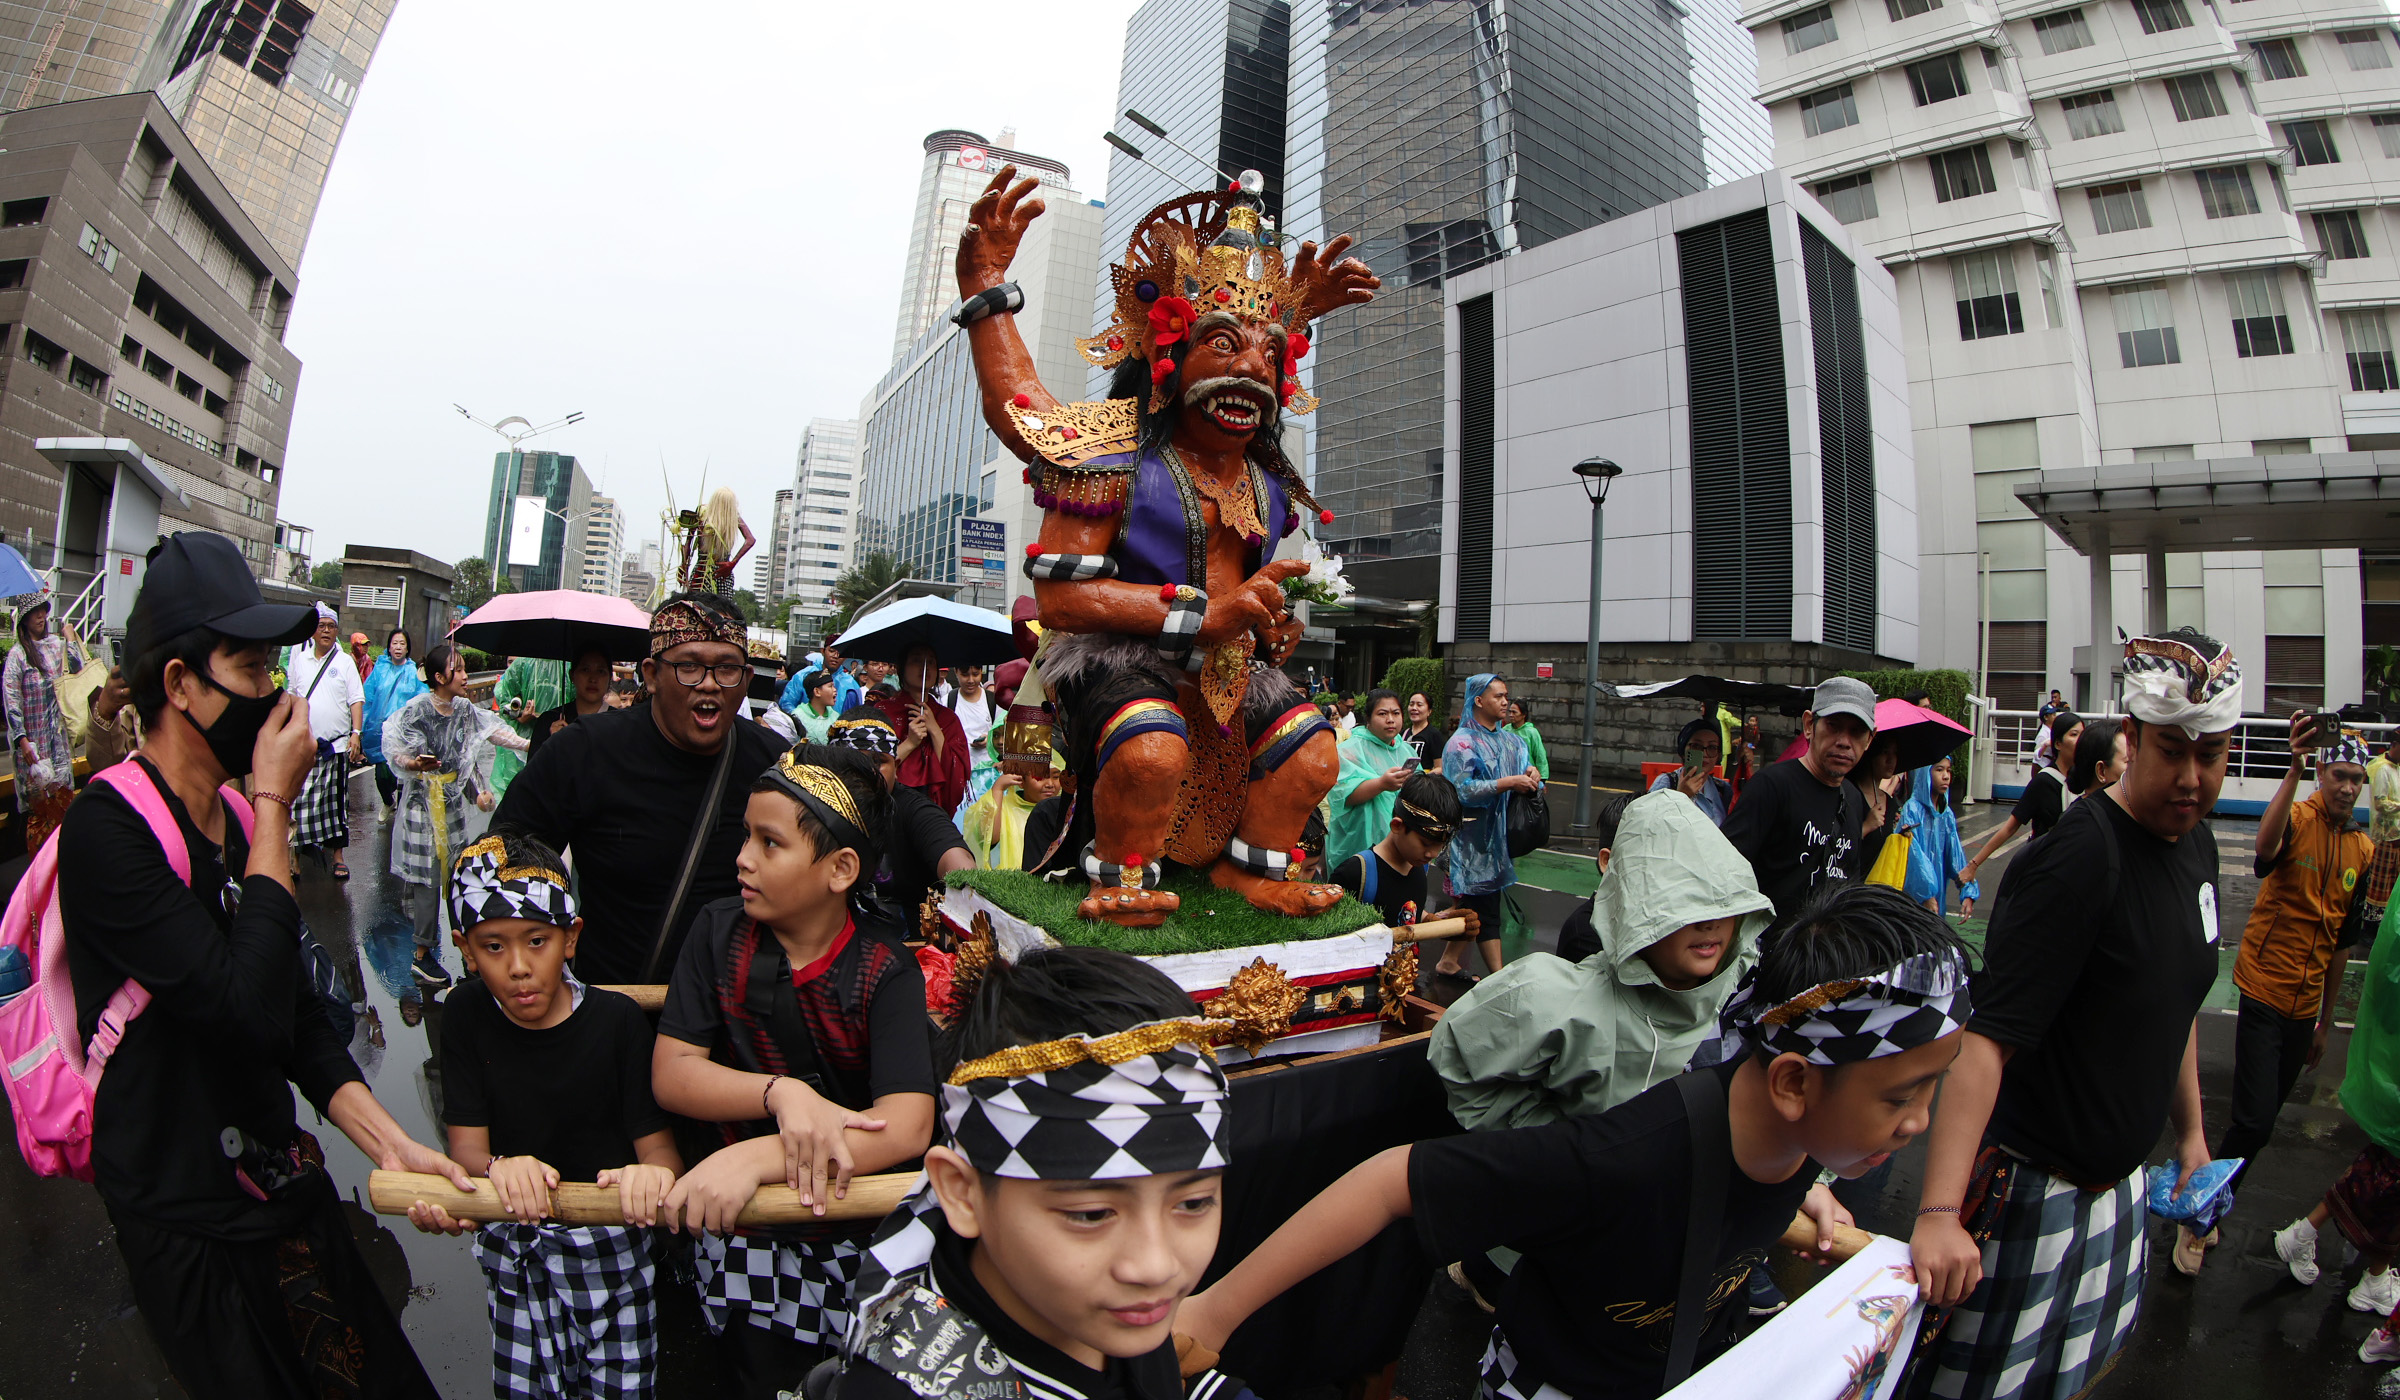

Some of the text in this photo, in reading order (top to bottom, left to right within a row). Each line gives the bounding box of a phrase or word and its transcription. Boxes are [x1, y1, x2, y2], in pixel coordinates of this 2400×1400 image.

[988, 157, 1065, 181] siarmas
[962, 529, 1004, 540] BANK INDEX
[971, 522, 995, 531] PLAZA
[917, 1318, 968, 1372] CHOMP!
